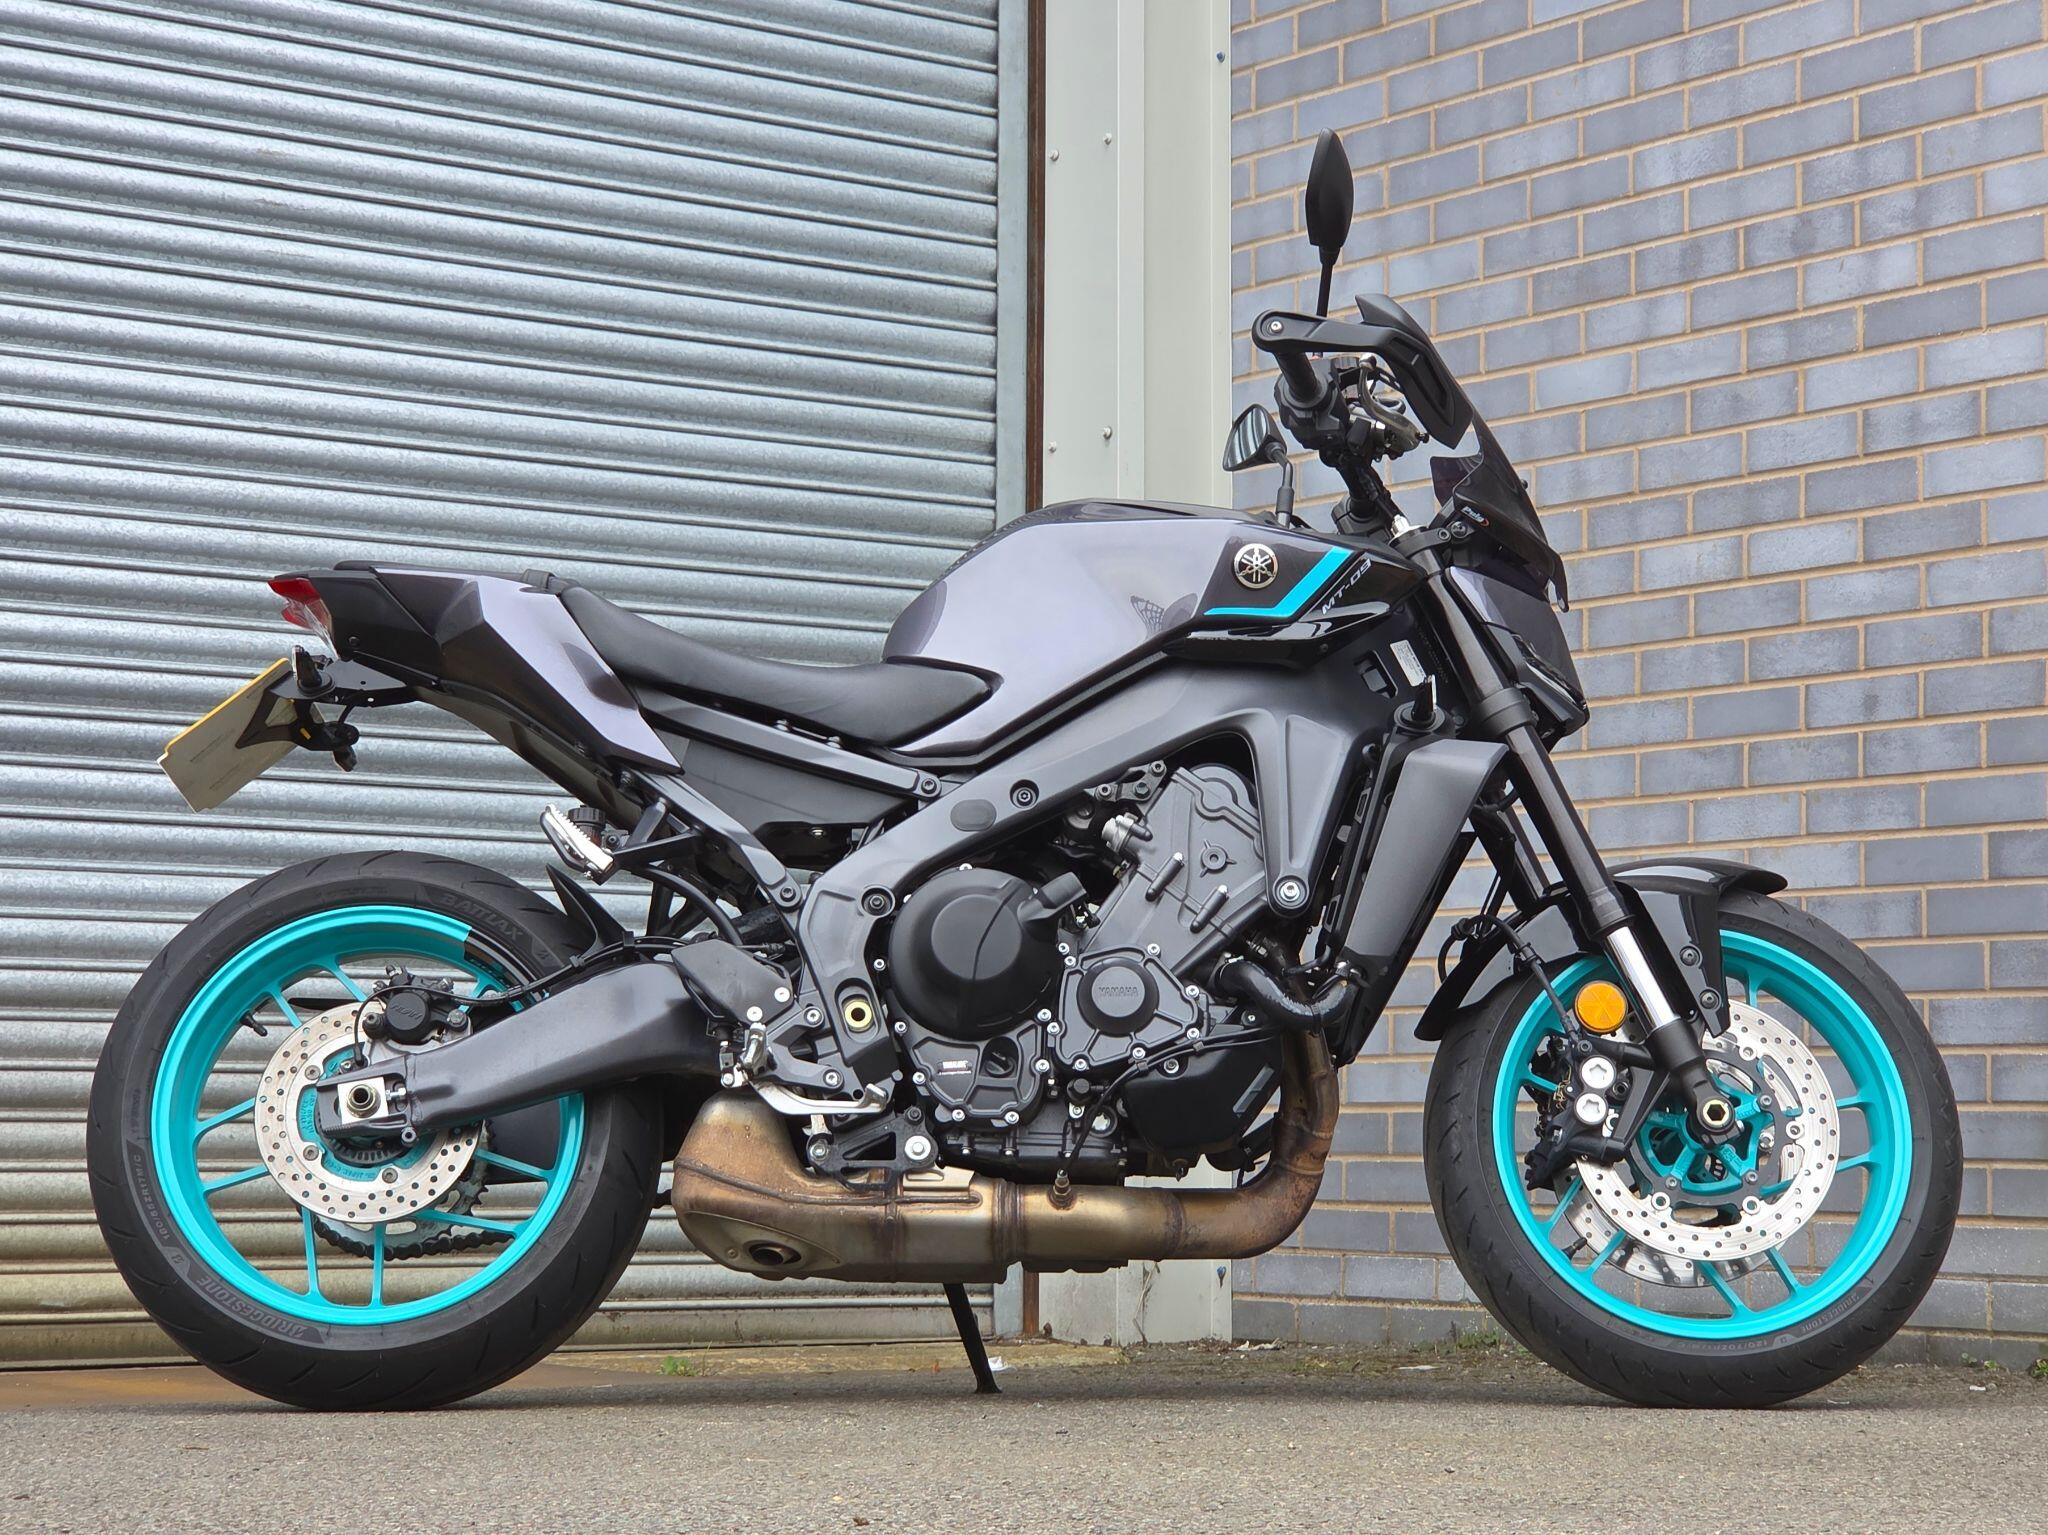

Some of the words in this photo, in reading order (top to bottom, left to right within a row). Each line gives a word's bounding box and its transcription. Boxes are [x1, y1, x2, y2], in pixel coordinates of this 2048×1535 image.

[1321, 558, 1372, 615] MT-09
[442, 893, 523, 940] BATTLAX
[1098, 985, 1139, 996] YAMAHA
[197, 1275, 305, 1338] BRIDGESTONE
